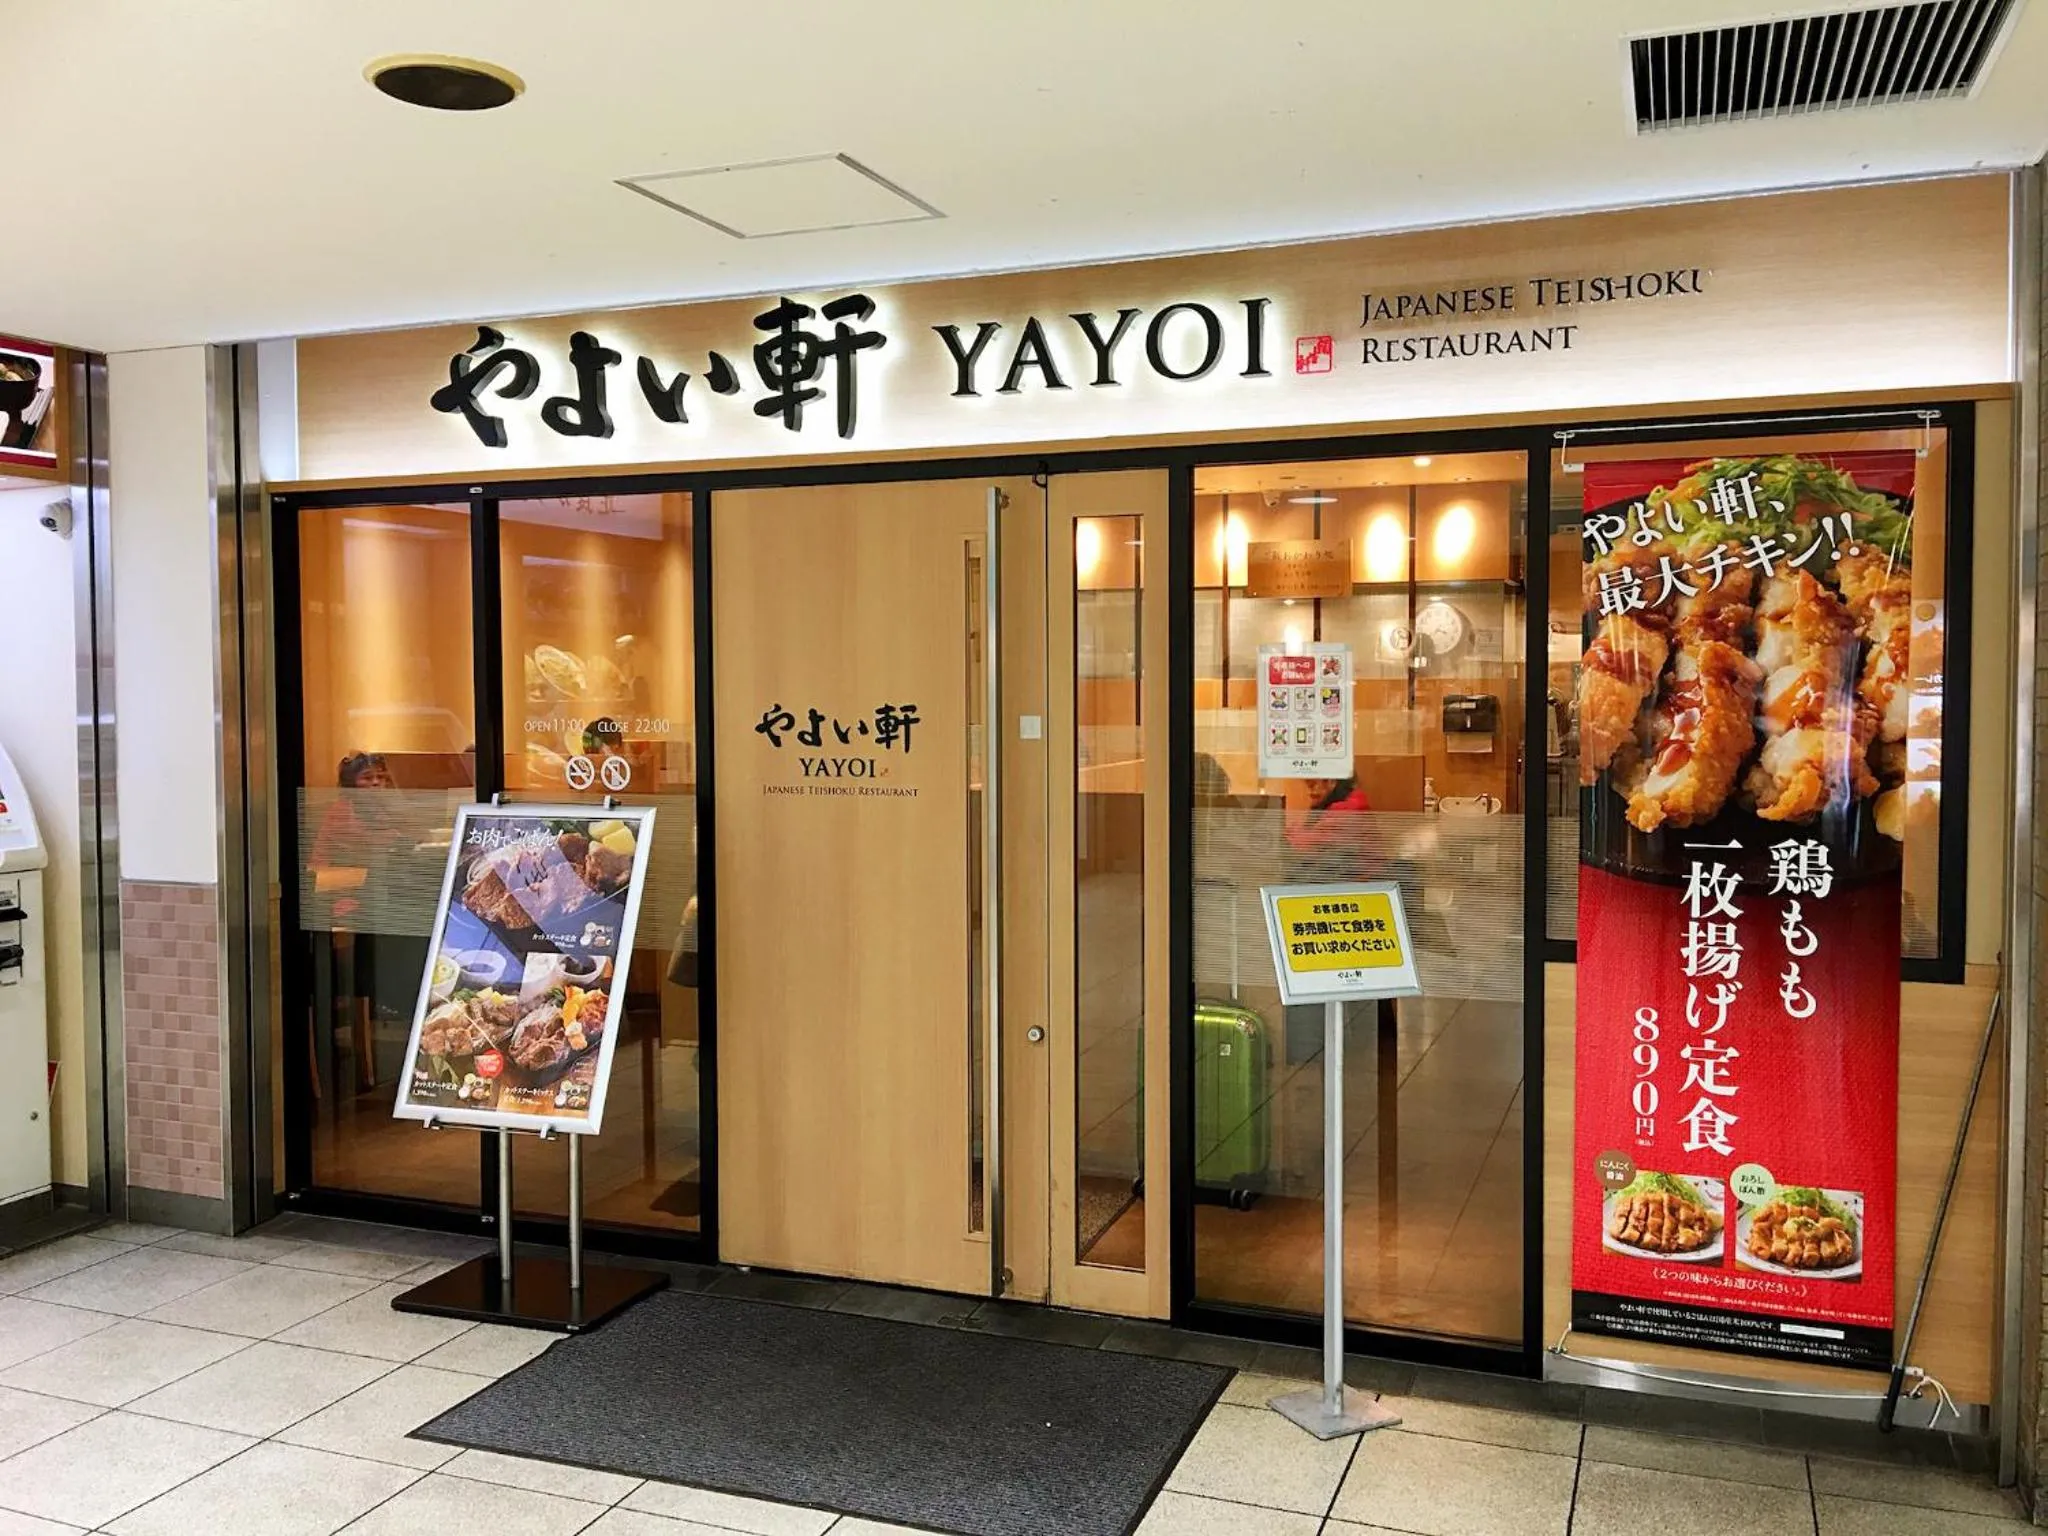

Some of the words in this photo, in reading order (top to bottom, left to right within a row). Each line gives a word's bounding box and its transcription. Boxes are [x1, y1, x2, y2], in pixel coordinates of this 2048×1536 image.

[1360, 286, 1515, 329] JAPANESE
[932, 298, 1271, 398] YAYOI
[1361, 326, 1578, 364] RESTAURANT
[430, 294, 887, 448] やよい軒
[1597, 511, 1860, 617] 最大チキン!!
[524, 720, 551, 733] OPEN
[552, 717, 585, 733] 11:00
[597, 720, 629, 733] CLOSE
[634, 718, 670, 733] 22:00
[754, 704, 921, 754] やよい軒
[799, 758, 876, 778] YAYOI
[763, 784, 805, 796] JAPANESE
[858, 786, 919, 797] RESTAURANT
[1292, 919, 1386, 936] 券売機にて食券を
[1767, 838, 1835, 1019] 鶏もも
[1291, 938, 1396, 956] お買い求めください
[1677, 838, 1745, 1157] 一枚揚げ定食
[1600, 1160, 1630, 1171] にんにく
[1741, 1174, 1765, 1185] おろし
